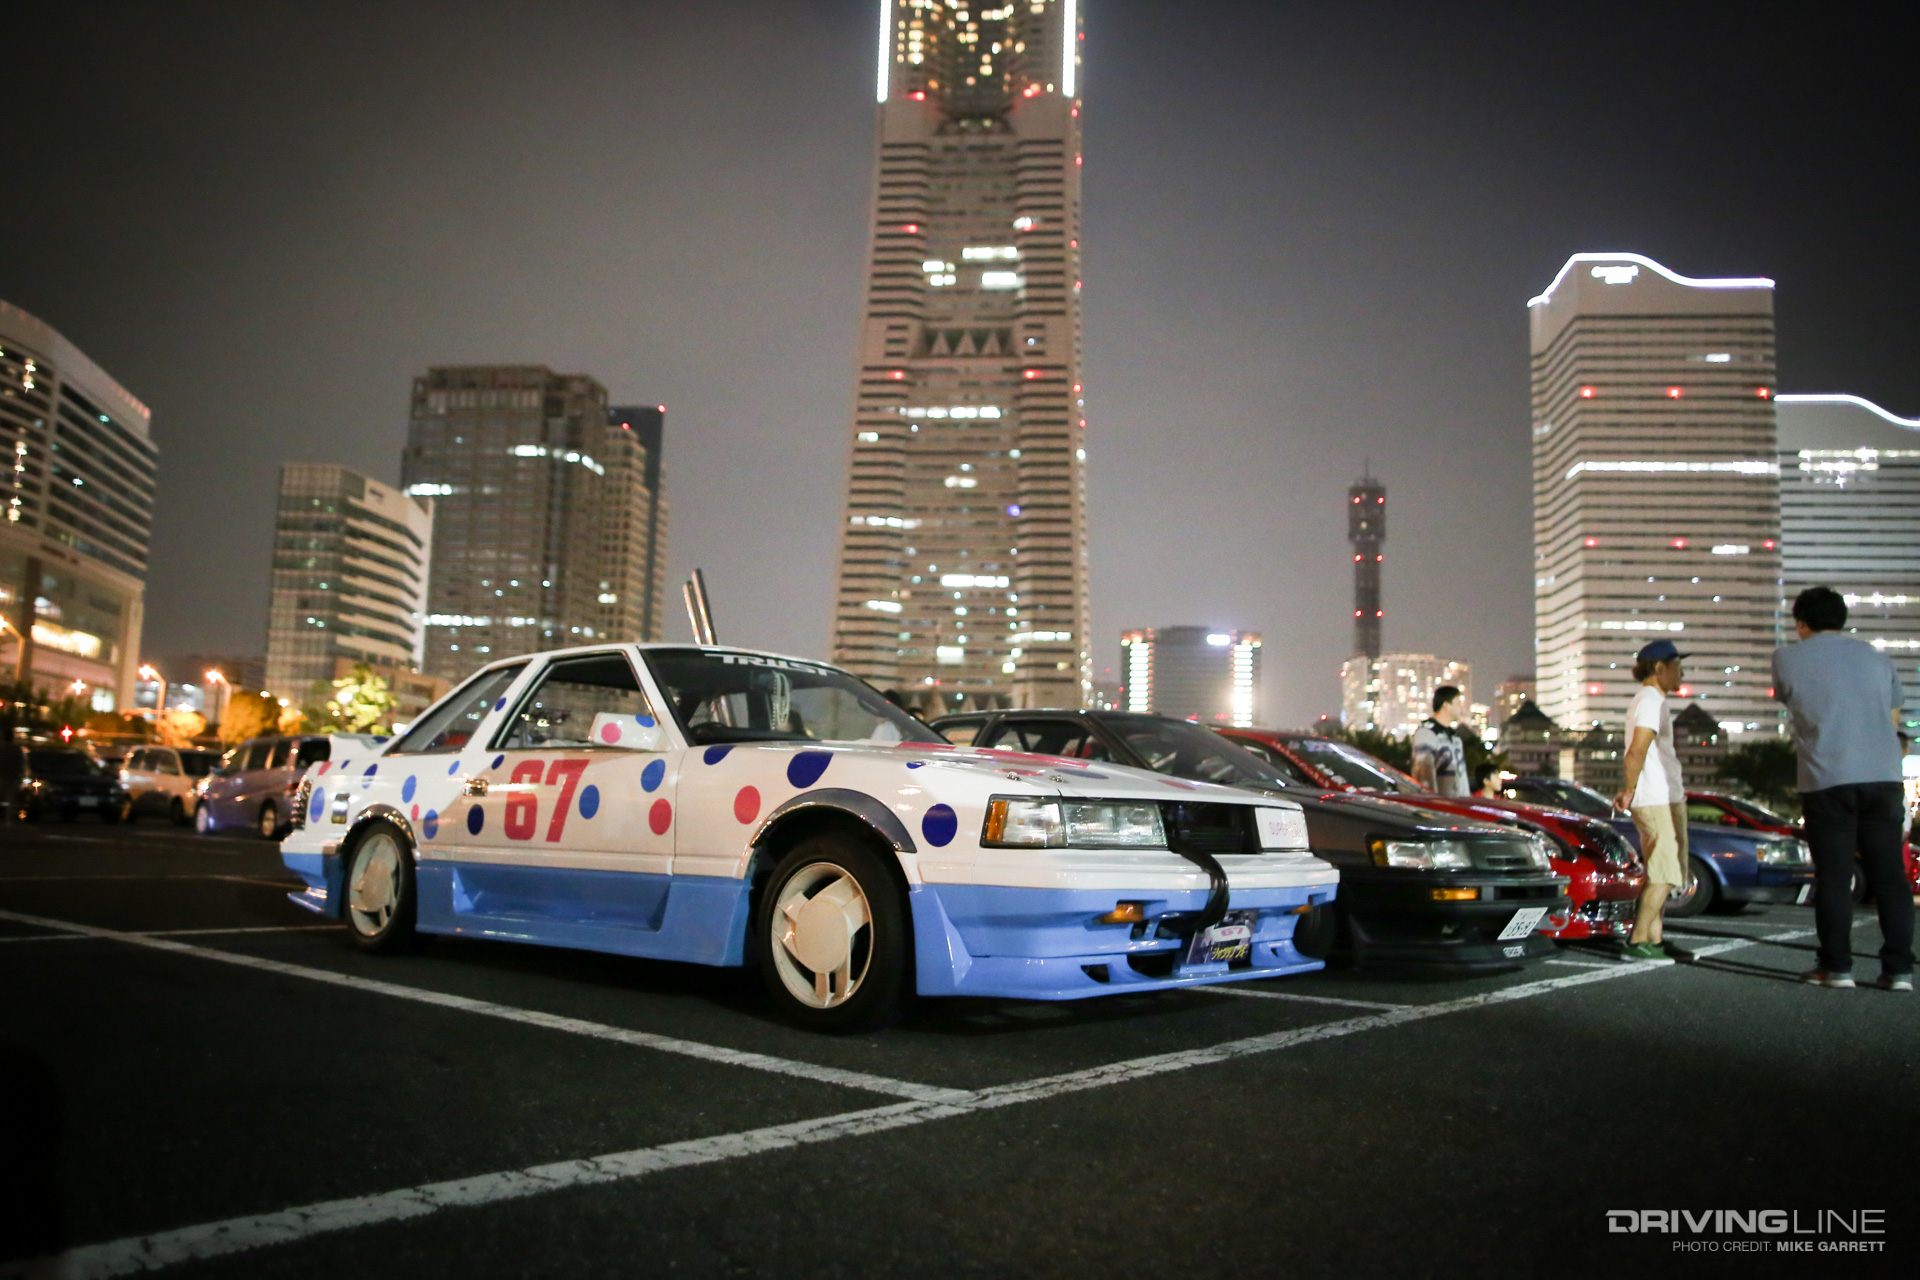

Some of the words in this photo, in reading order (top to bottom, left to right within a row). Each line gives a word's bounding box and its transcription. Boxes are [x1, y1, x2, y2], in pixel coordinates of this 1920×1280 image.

[704, 653, 839, 676] TRUST
[504, 759, 590, 843] 67
[1221, 927, 1244, 936] 67
